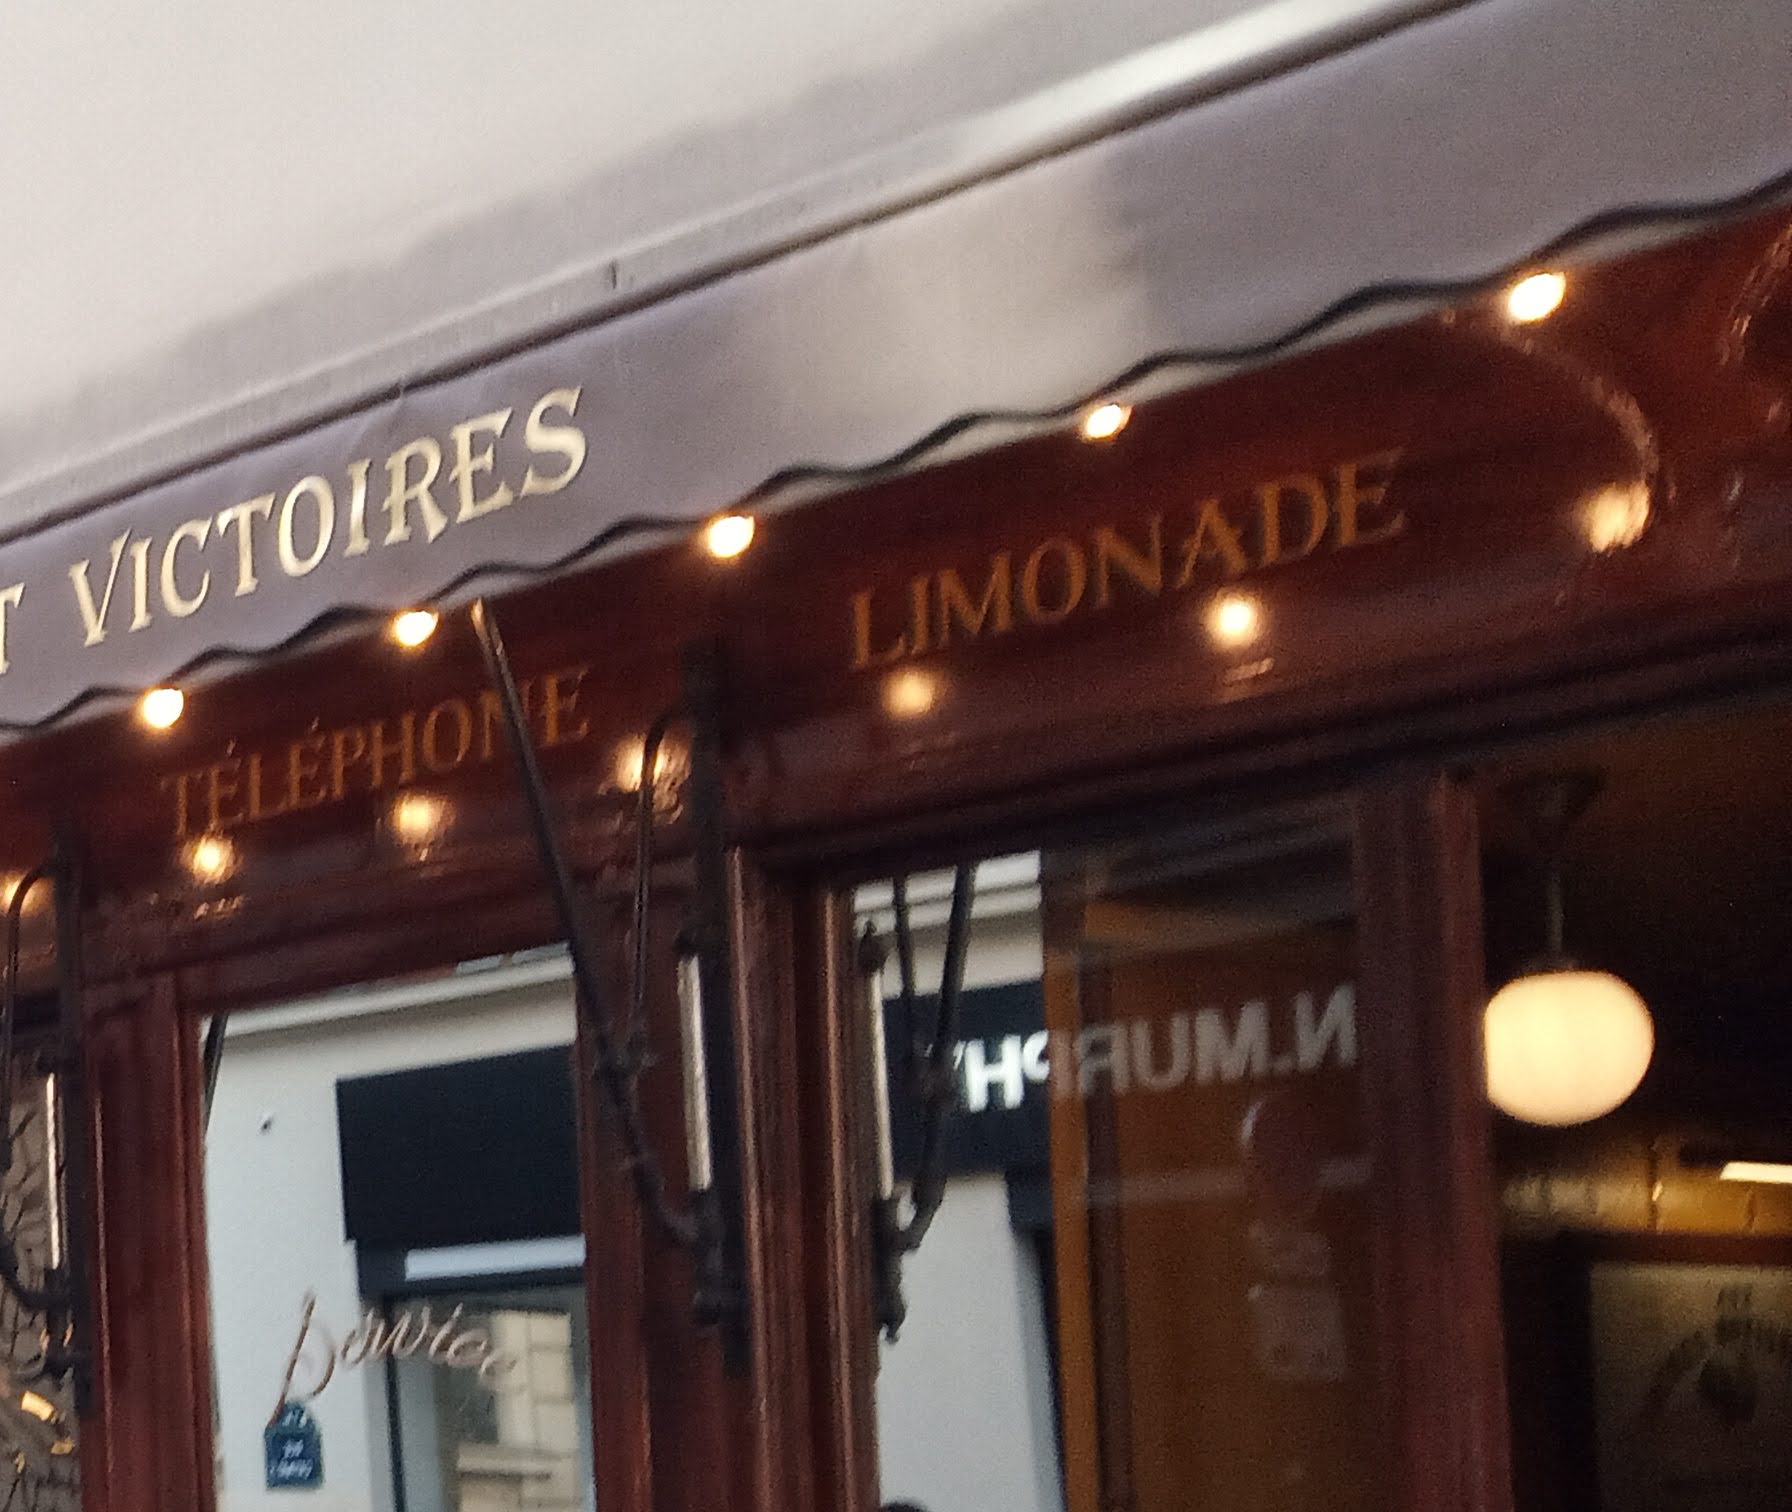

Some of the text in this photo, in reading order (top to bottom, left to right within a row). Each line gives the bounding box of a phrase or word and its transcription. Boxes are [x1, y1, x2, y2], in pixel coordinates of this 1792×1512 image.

[68, 387, 591, 648] VICTOIRES
[848, 446, 1410, 671] LIMONADE
[160, 666, 590, 838] TÉLÉPHONE
